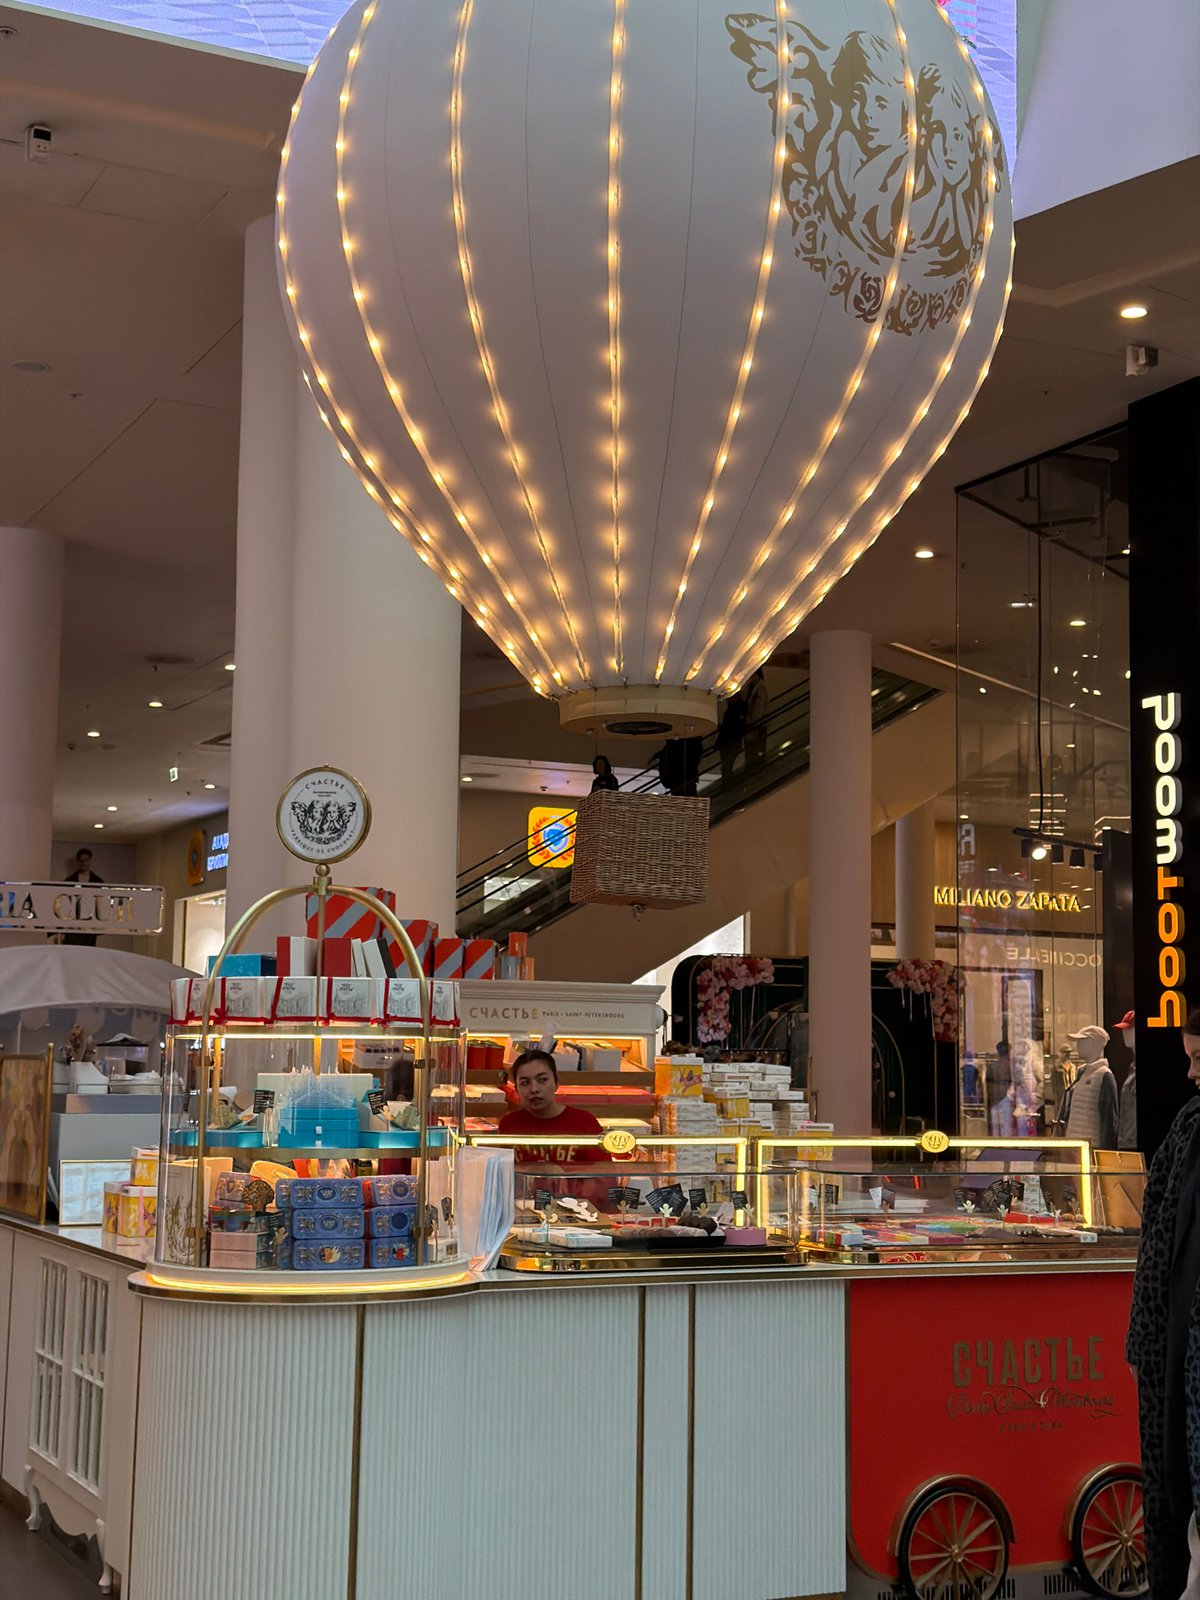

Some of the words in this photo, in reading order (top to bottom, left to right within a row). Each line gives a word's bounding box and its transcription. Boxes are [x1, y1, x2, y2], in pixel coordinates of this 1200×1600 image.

[305, 779, 345, 790] СЧАСТЬЕ
[933, 885, 1012, 909] MILIANO
[1015, 889, 1082, 913] ZAPATA
[469, 1006, 539, 1020] СЧАСТЬЕ
[952, 1335, 1105, 1388] СЧАСТЬЕ
